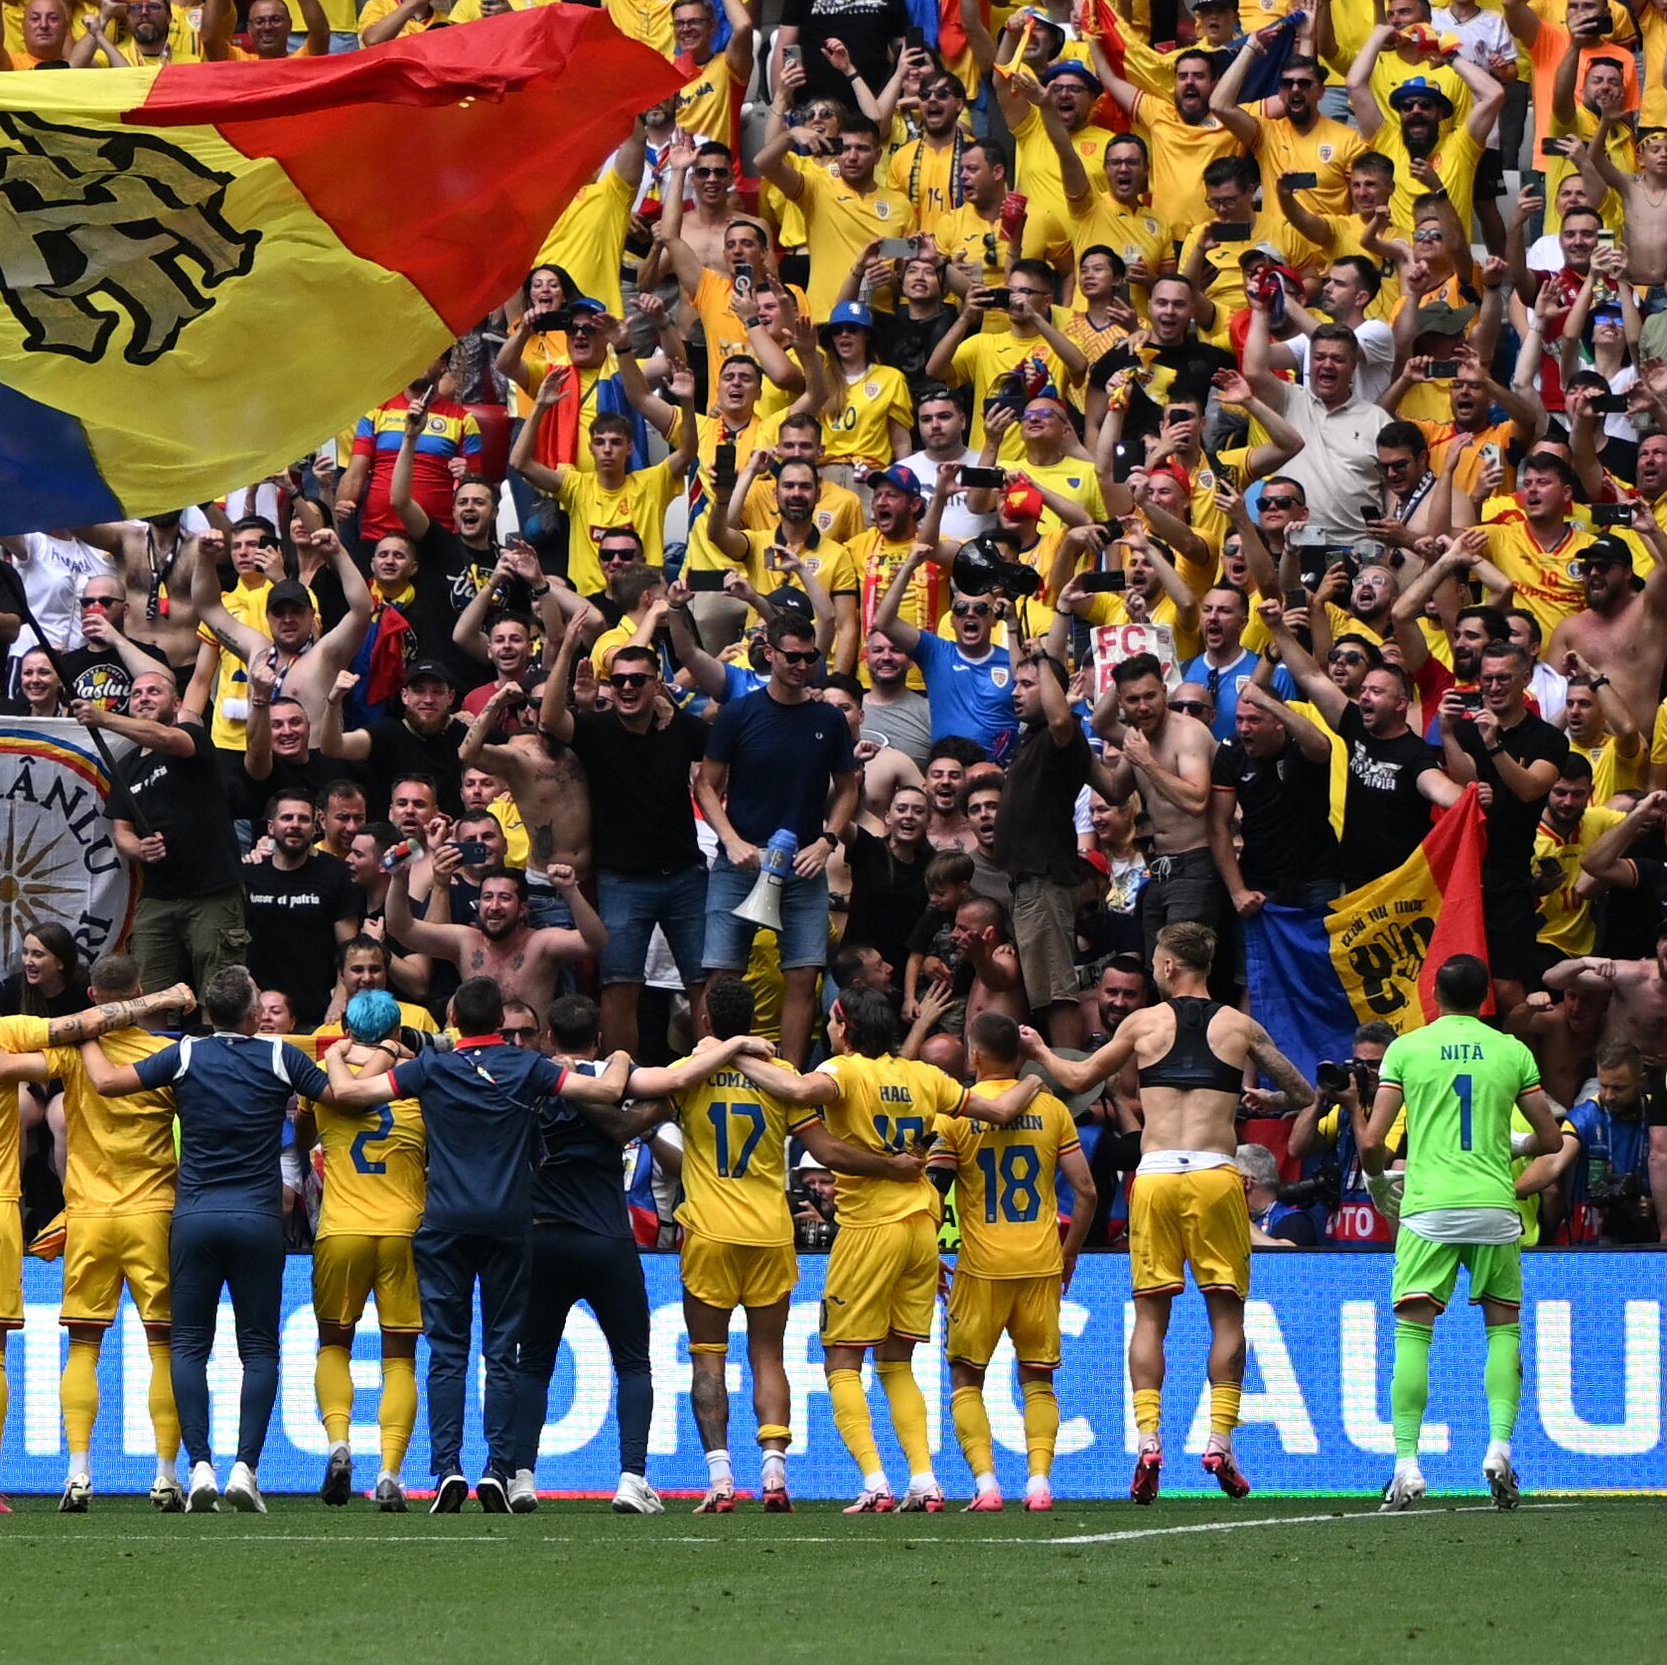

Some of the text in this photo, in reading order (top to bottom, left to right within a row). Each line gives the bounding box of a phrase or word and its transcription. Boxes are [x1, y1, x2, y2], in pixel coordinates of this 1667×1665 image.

[1099, 625, 1148, 656] FC
[350, 1103, 395, 1174] 2
[708, 1102, 766, 1178] 17
[1452, 1073, 1475, 1152] 1
[977, 1146, 1041, 1223] 18
